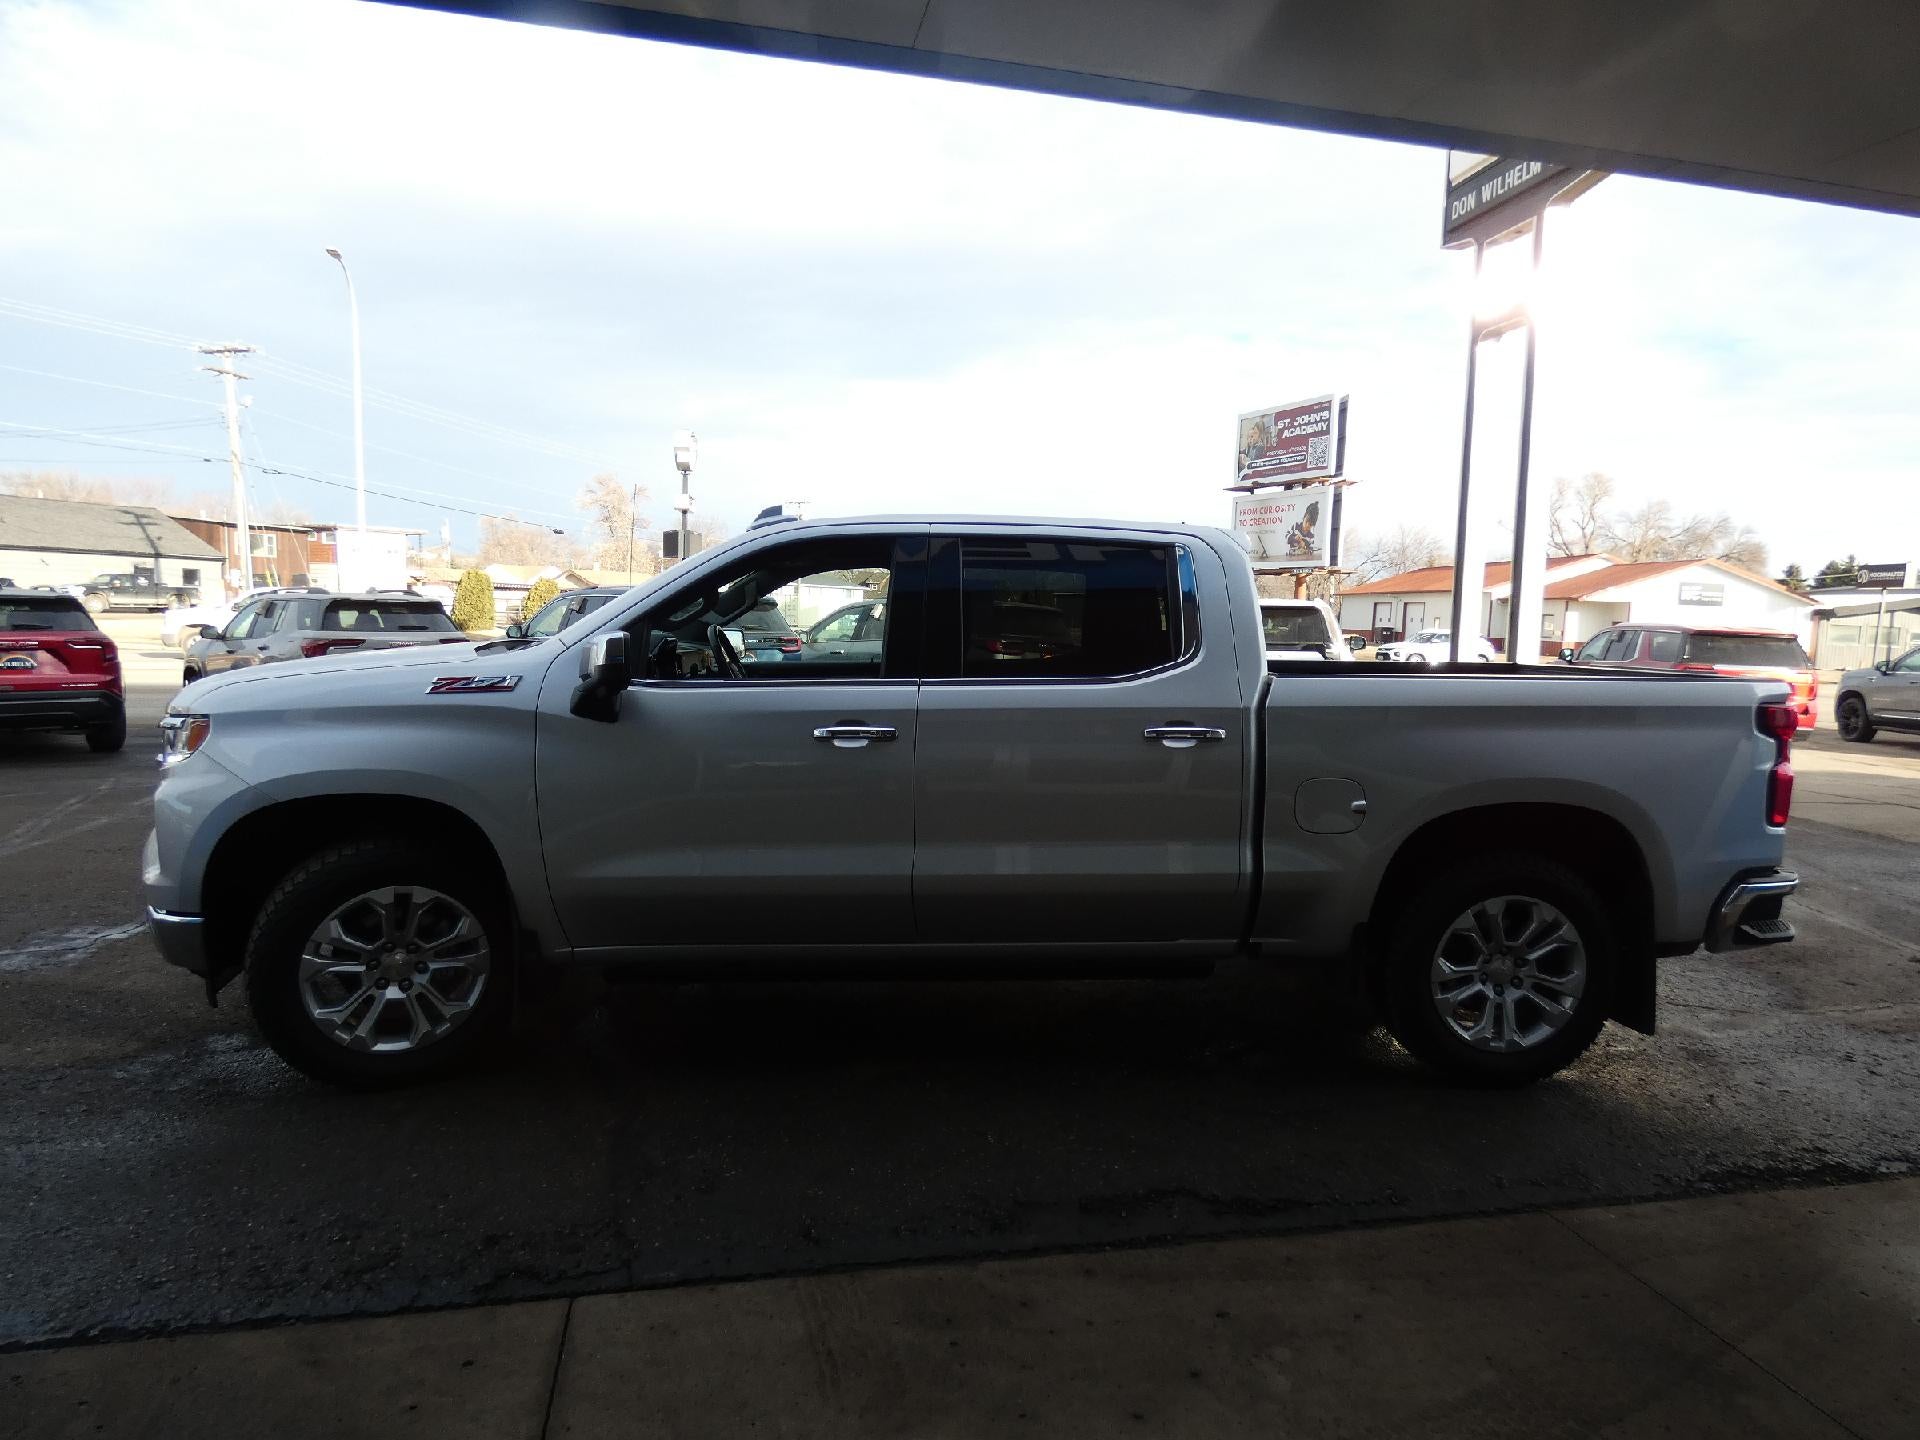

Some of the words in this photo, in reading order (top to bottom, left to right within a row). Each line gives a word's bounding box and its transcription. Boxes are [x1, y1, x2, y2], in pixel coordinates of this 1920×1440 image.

[1451, 191, 1476, 220] DON
[1481, 161, 1542, 203] WILHELM
[1277, 418, 1291, 429] ST.
[1293, 410, 1330, 426] JOHN'S
[1281, 421, 1329, 439] ACADEMY
[1239, 507, 1258, 516] FROM
[1259, 503, 1296, 515] CURIOSITY
[1238, 519, 1248, 527] TO
[1249, 516, 1283, 527] CREATION
[424, 674, 523, 695] Z71
